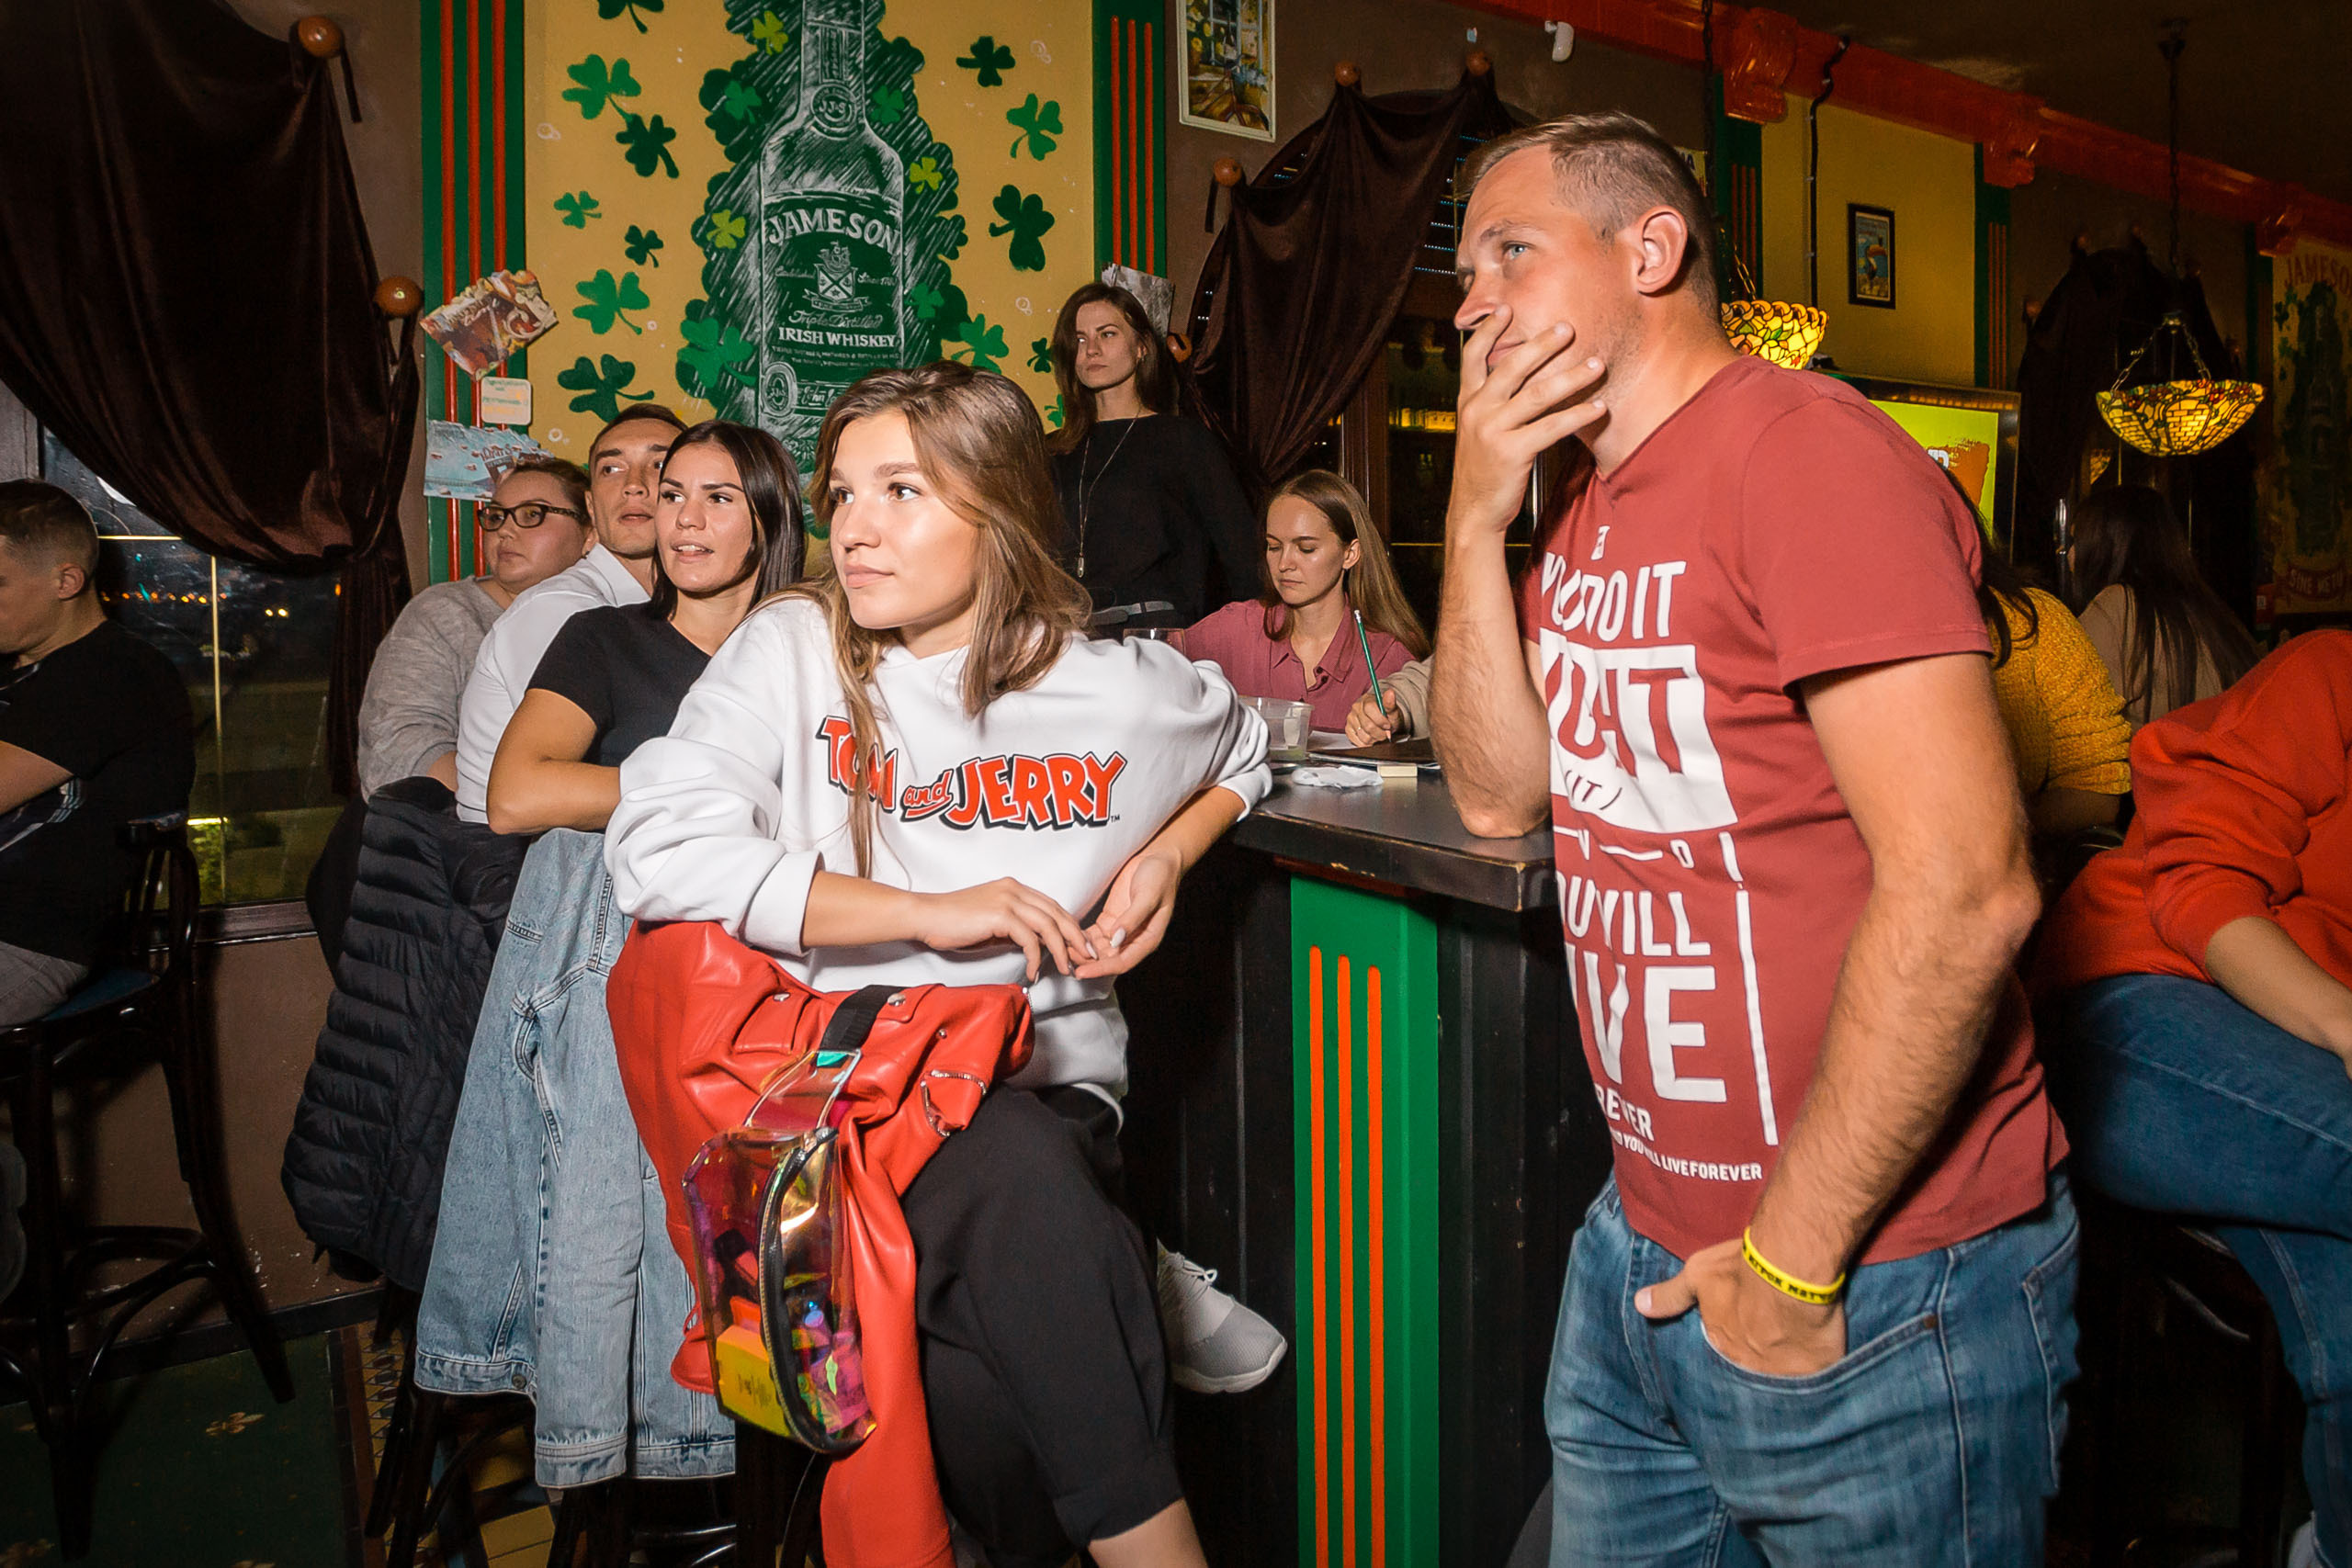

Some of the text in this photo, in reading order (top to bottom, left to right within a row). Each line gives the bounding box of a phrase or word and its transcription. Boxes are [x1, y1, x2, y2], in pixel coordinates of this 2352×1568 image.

[768, 208, 901, 255] JAMESON
[778, 326, 897, 348] IRISH WHISKEY
[899, 768, 955, 821] and
[939, 750, 1127, 831] JERRY
